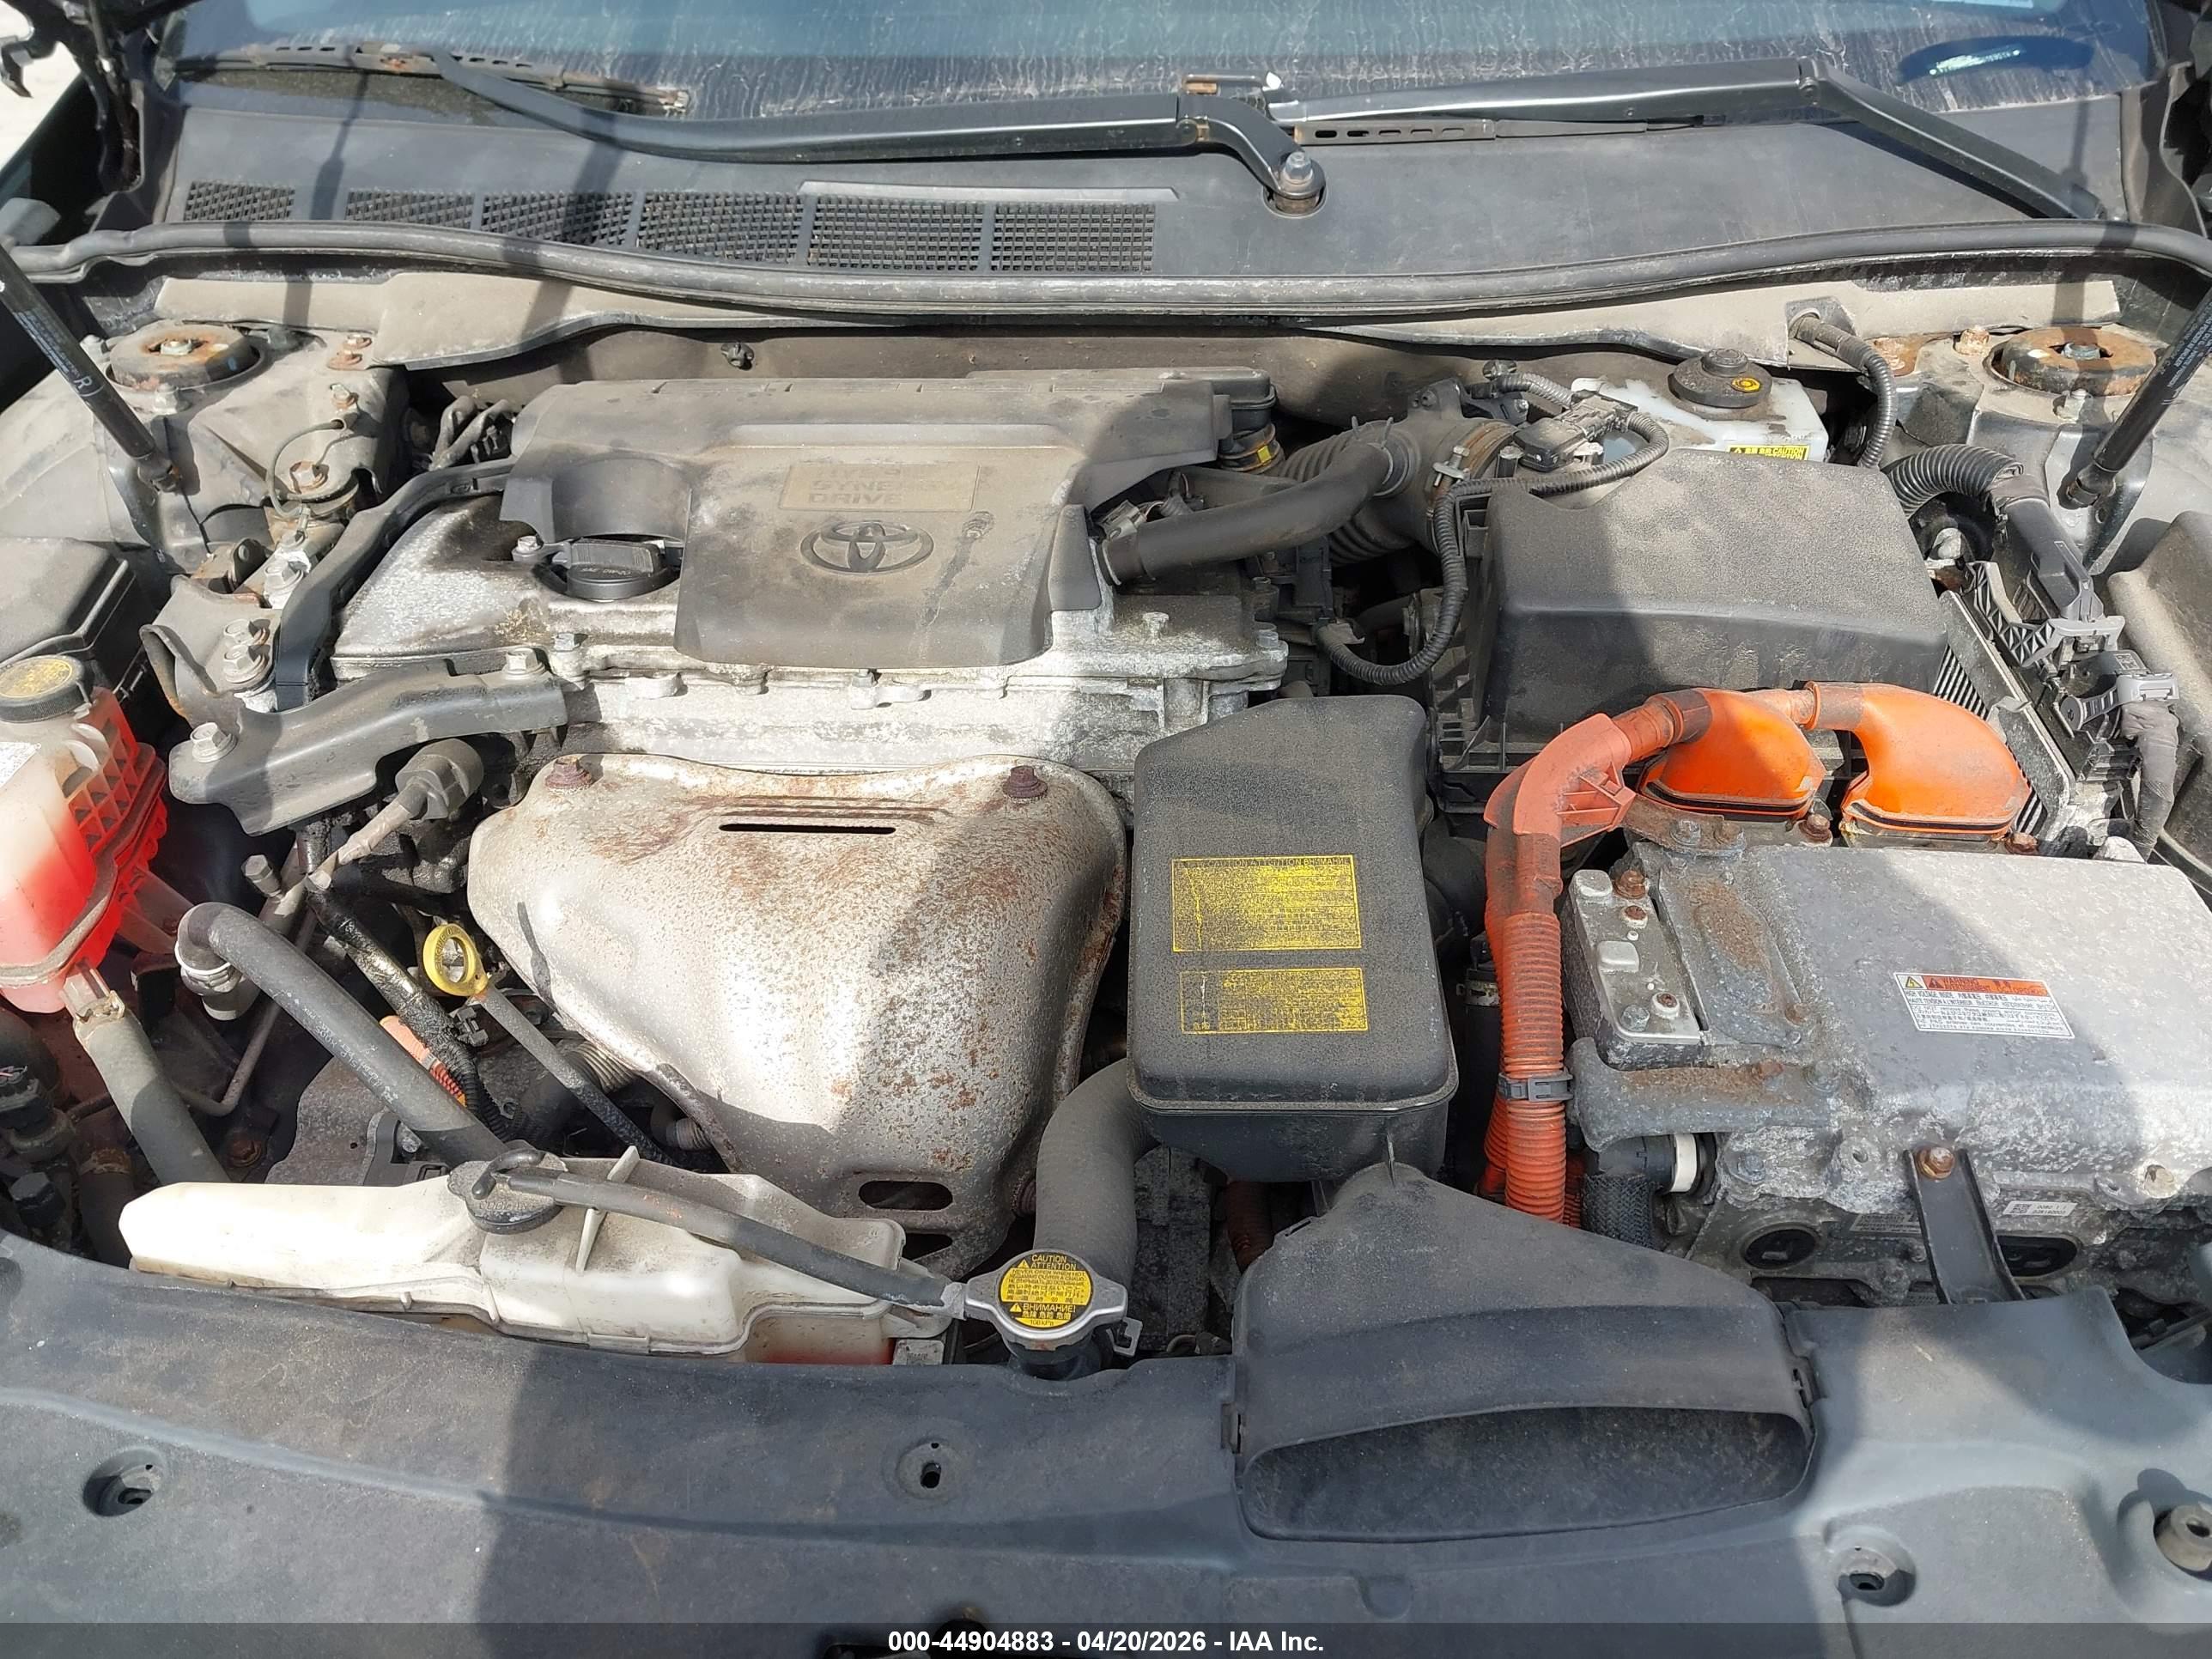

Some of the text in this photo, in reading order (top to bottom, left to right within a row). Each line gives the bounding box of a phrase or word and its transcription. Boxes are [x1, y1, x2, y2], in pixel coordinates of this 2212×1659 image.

[1772, 447, 1804, 455] CAUTION
[809, 493, 902, 505] DRIVE
[1030, 1261, 1076, 1270] ATTENTION
[1023, 1303, 1076, 1313] ВНИМАНИЕ!
